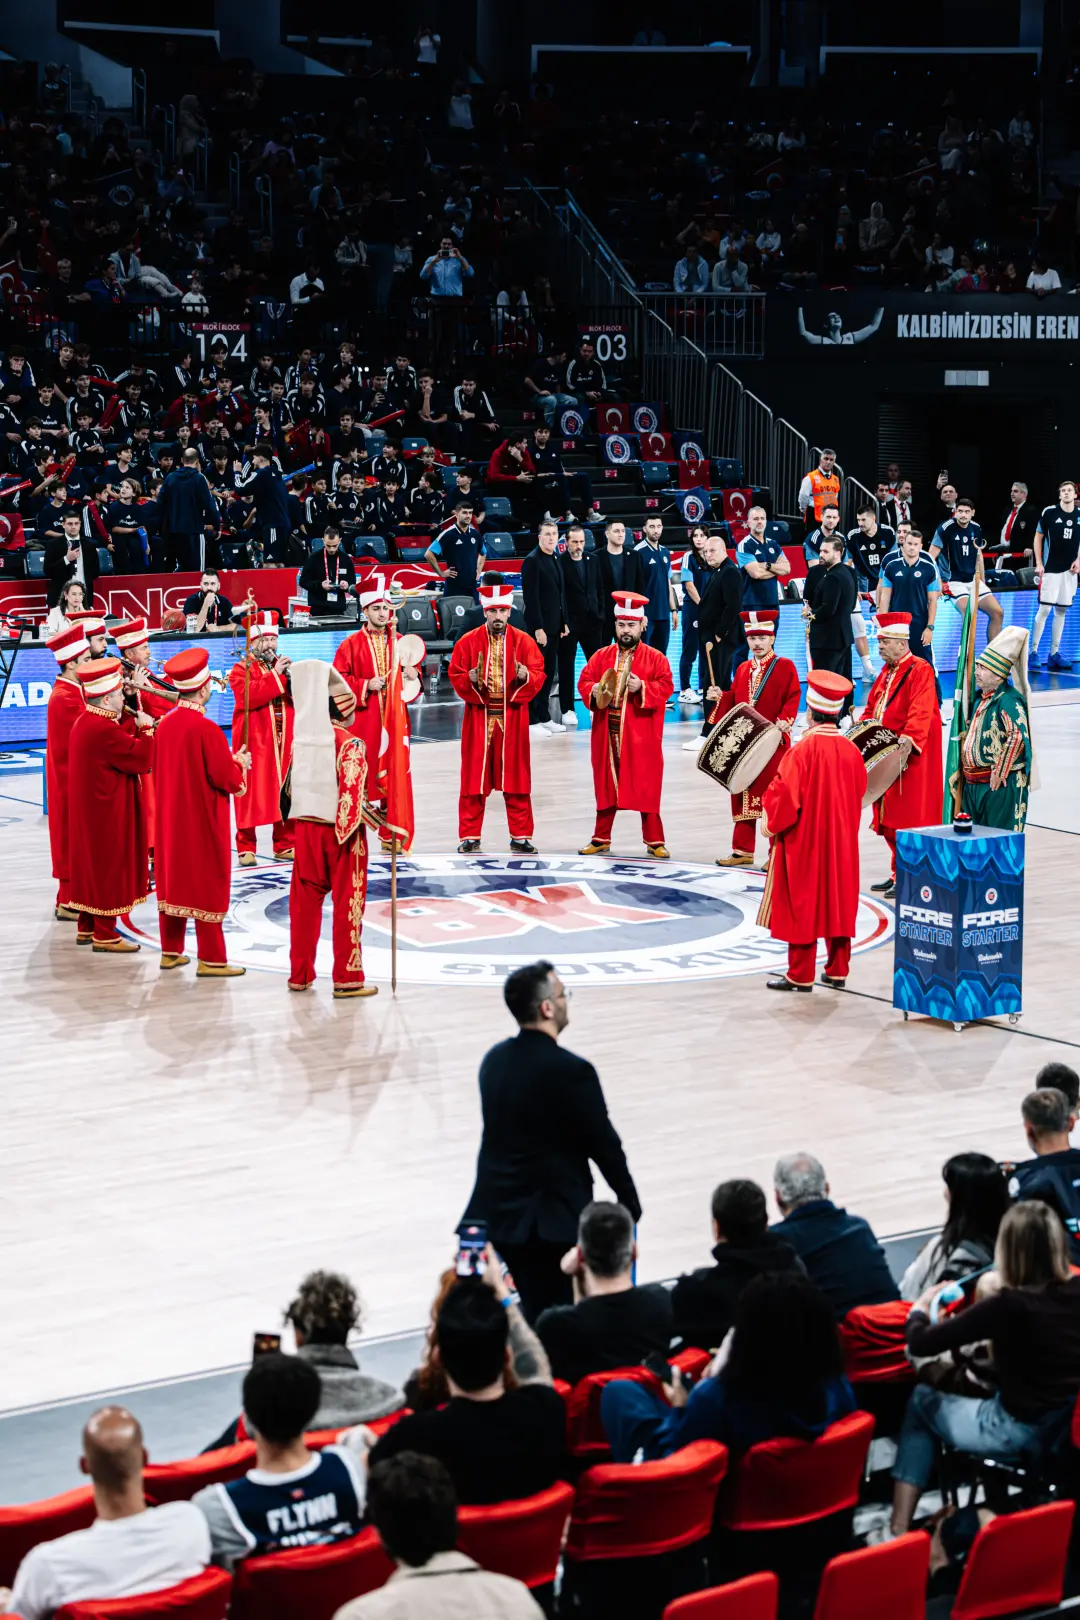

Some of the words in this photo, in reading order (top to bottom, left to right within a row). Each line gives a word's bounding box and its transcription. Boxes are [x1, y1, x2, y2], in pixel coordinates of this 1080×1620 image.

[202, 323, 217, 331] BLOK
[221, 323, 240, 331] BLOCK
[897, 311, 1031, 339] KALBİMİZDESİN
[1036, 315, 1079, 339] EREN
[582, 334, 627, 361] 03
[899, 903, 953, 929] FIRE
[962, 907, 1019, 929] FIRE
[899, 920, 953, 947] STARTER
[962, 924, 1019, 947] STARTER
[266, 1492, 338, 1534] FLYNN
